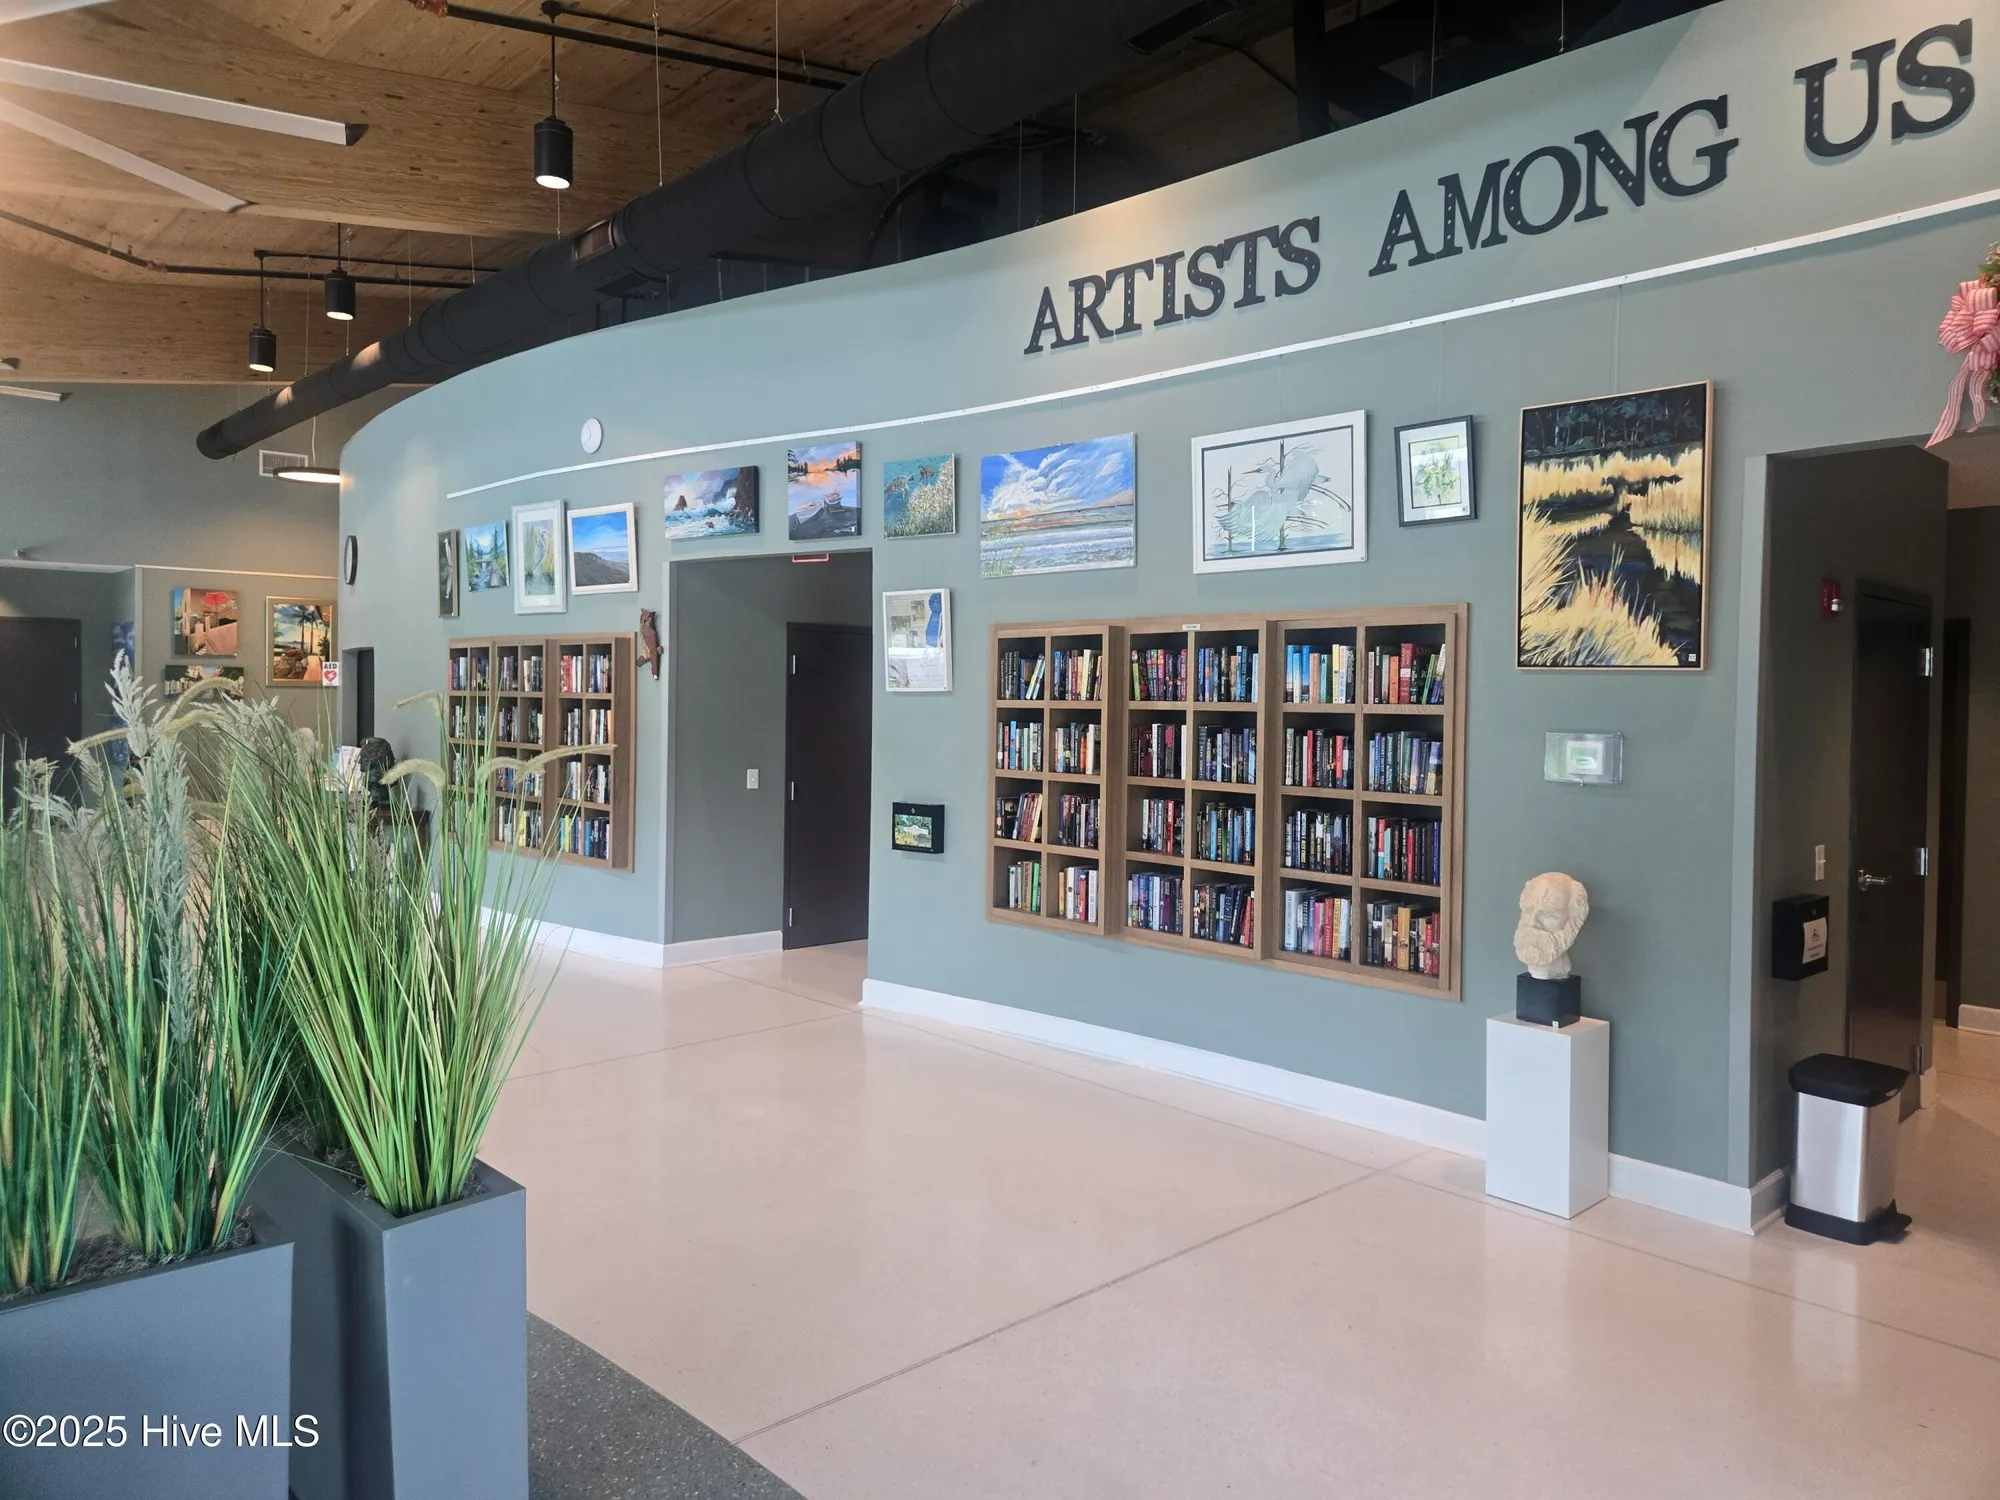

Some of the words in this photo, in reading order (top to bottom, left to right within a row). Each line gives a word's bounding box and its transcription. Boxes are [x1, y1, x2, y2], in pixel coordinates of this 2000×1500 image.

[1023, 215, 1322, 355] ARTISTS
[1369, 94, 1739, 277] AMONG
[1795, 18, 1976, 157] US
